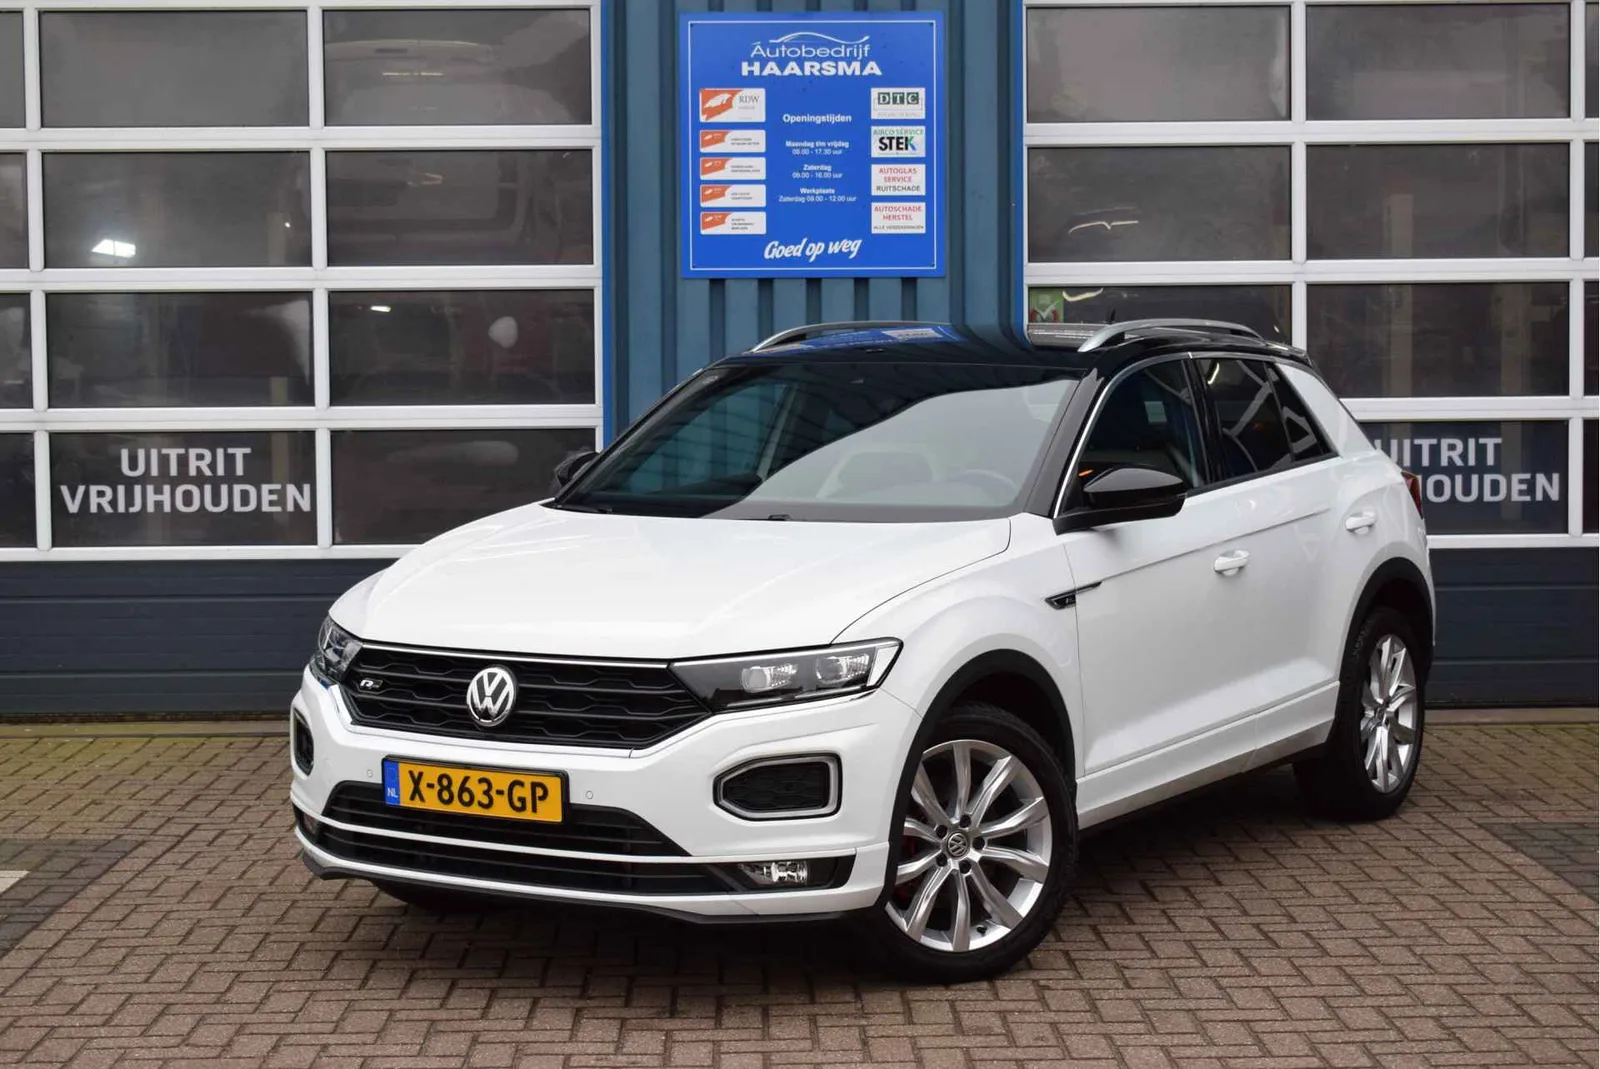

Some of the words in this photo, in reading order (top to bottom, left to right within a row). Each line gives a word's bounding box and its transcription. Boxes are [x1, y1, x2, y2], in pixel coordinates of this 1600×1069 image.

[750, 44, 871, 60] Autobedrijf
[741, 61, 883, 76] HAARSMA
[878, 92, 919, 105] DTC
[782, 113, 852, 123] Openingstijden
[827, 140, 850, 148] vrijdag
[878, 136, 917, 151] STEK
[779, 195, 806, 203] Zaterdag
[763, 238, 808, 259] Goed
[805, 242, 826, 263] op
[827, 238, 863, 259] weg
[120, 447, 252, 477] UITRIT
[1417, 472, 1560, 503] OUDEN
[59, 482, 312, 514] VRIJHOUDEN
[387, 787, 400, 799] NL
[408, 769, 549, 814] X-863-GP
